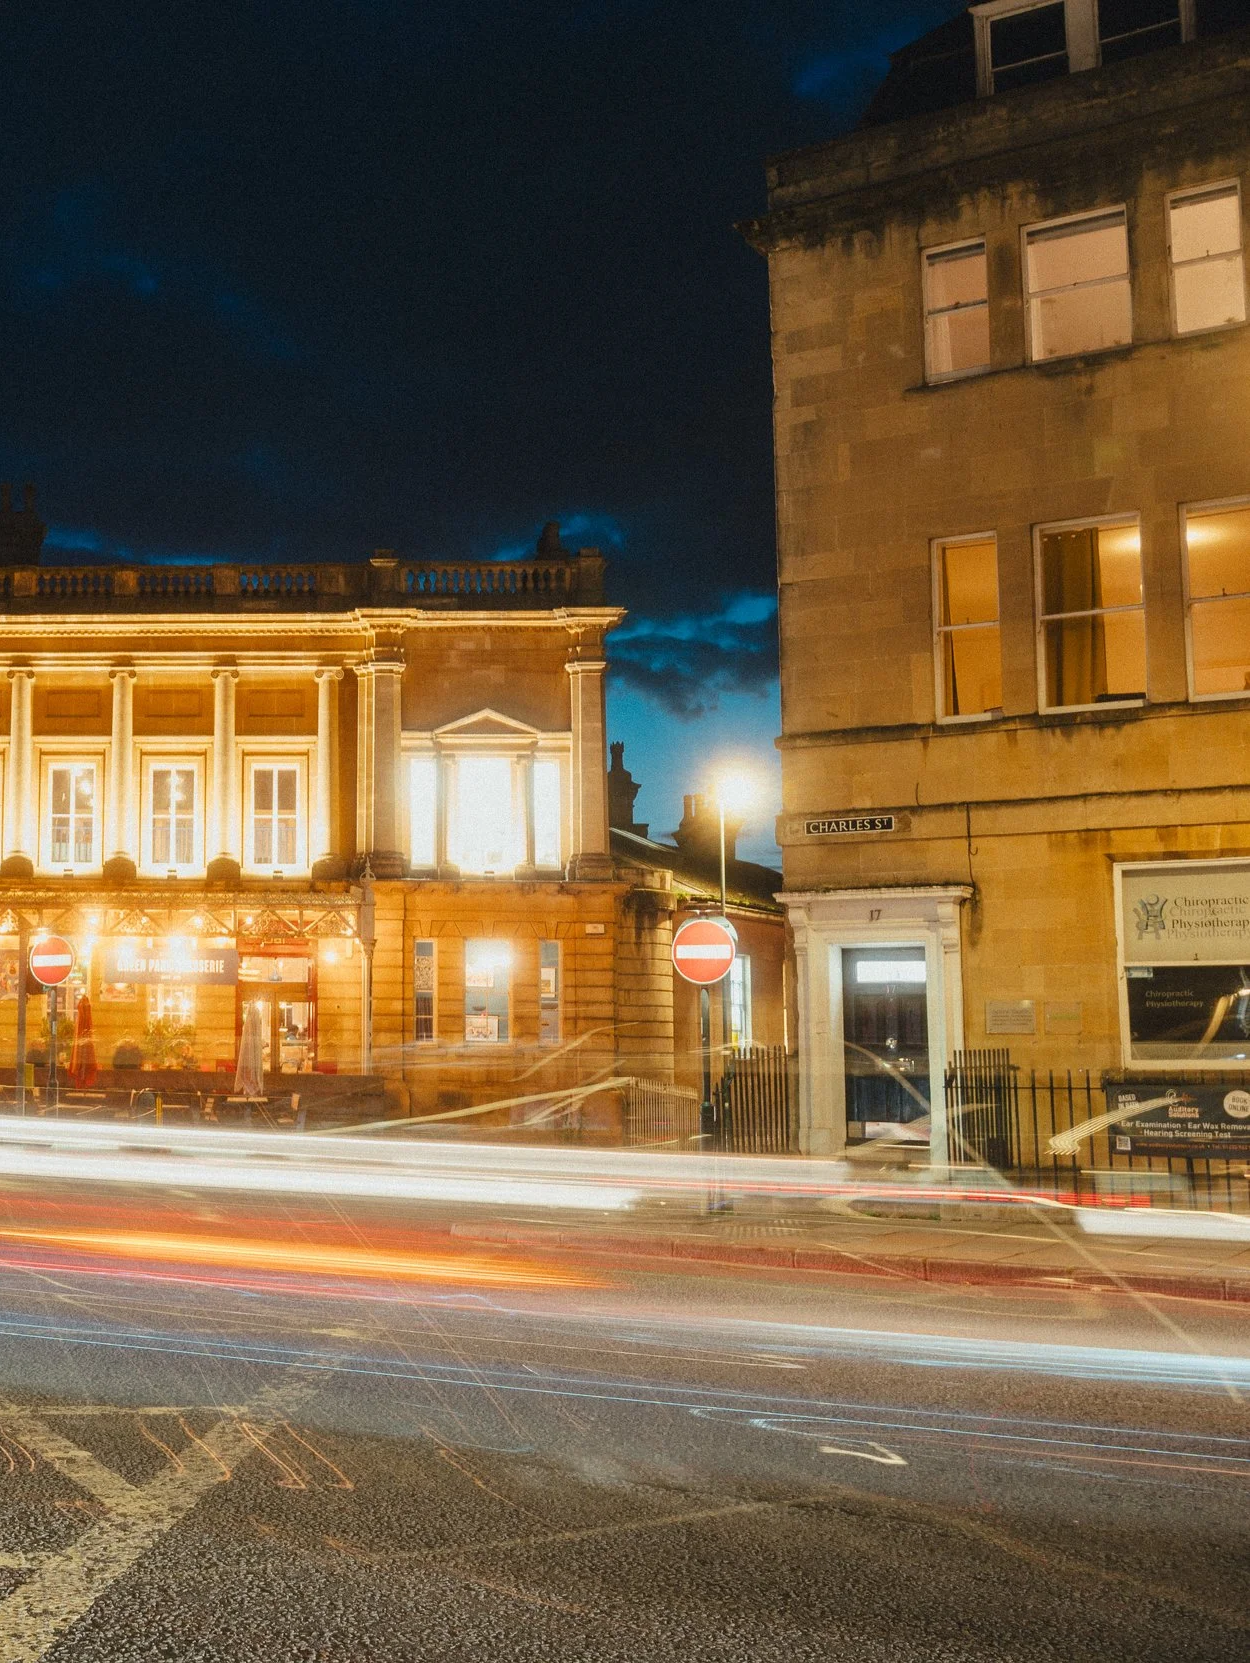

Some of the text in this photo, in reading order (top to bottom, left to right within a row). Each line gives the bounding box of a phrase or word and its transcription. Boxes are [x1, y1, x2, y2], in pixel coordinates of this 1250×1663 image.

[810, 819, 871, 833] CHARLES
[1174, 896, 1249, 908] Chiropractic
[869, 909, 882, 921] 17
[1145, 989, 1194, 999] Chiropractic
[1146, 1000, 1204, 1008] Physiotherapy
[1231, 1096, 1248, 1104] BOOK
[1168, 1105, 1199, 1113] Auditory
[1228, 1104, 1249, 1112] ONLINE
[1121, 1120, 1133, 1128] Ear
[1135, 1121, 1181, 1129] Examination
[1202, 1122, 1219, 1130] Wax
[1143, 1130, 1171, 1139] Hearing
[1174, 1130, 1213, 1140] Screening
